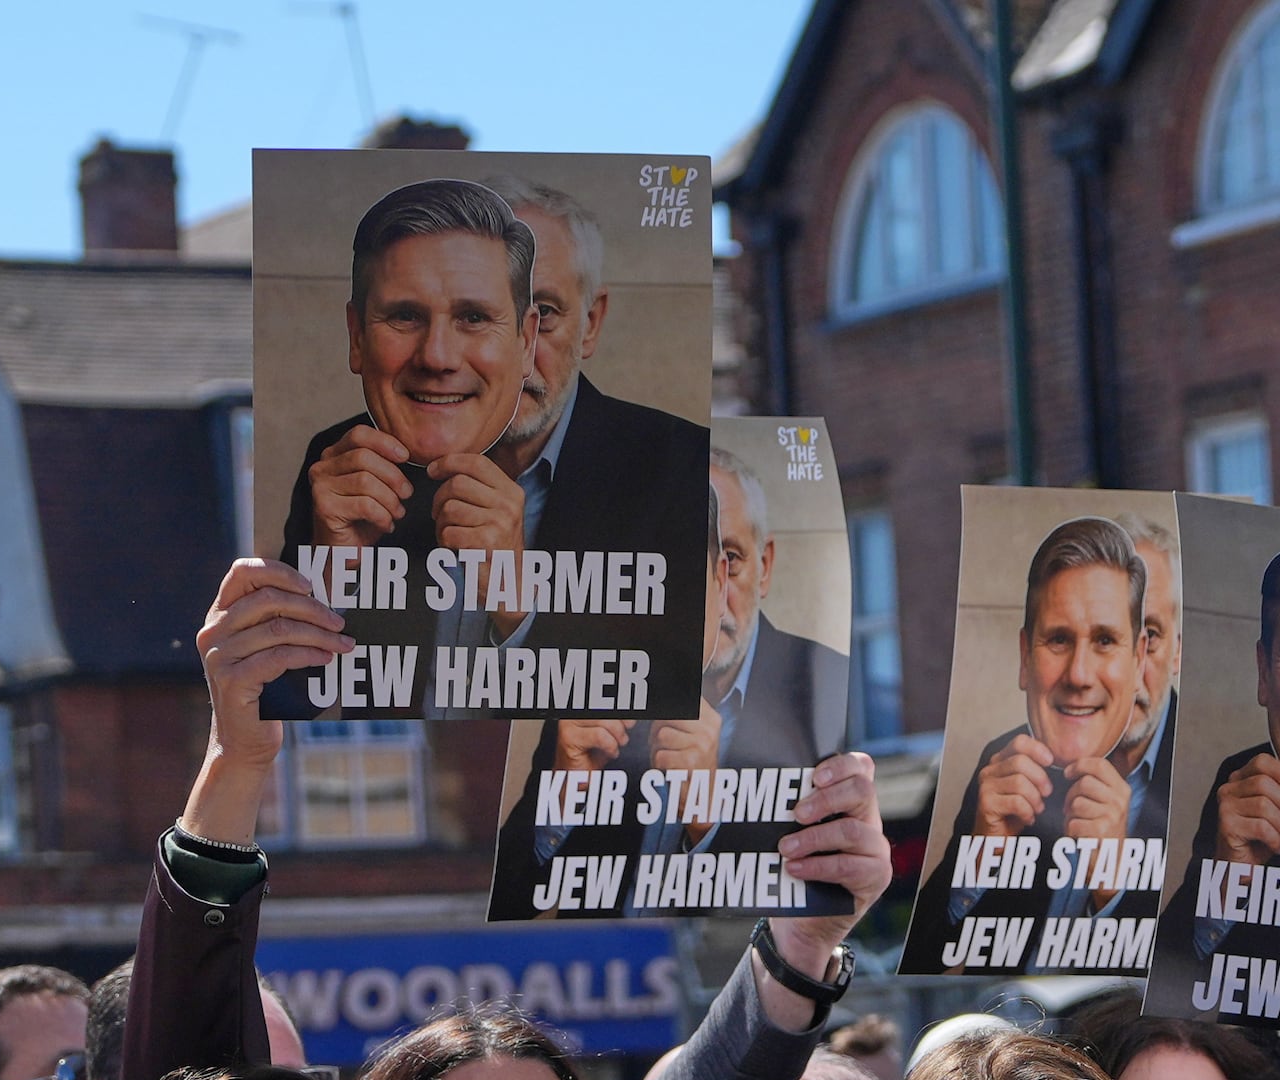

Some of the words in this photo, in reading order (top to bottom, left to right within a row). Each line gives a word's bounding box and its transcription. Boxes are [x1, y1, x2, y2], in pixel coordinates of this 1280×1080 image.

[640, 206, 694, 228] HATE
[646, 186, 690, 207] THE
[785, 444, 817, 463] THE
[786, 462, 824, 482] HATE
[297, 544, 410, 612] KEIR
[424, 547, 669, 616] STARMER
[306, 644, 420, 709] JEW
[434, 646, 651, 712] HARMER
[534, 768, 629, 827] KEIR
[636, 765, 816, 826] STARME
[532, 854, 629, 911] JEW
[950, 834, 1041, 890] KEIR
[941, 916, 1029, 969] JEW
[273, 955, 677, 1031] WOODALLS
